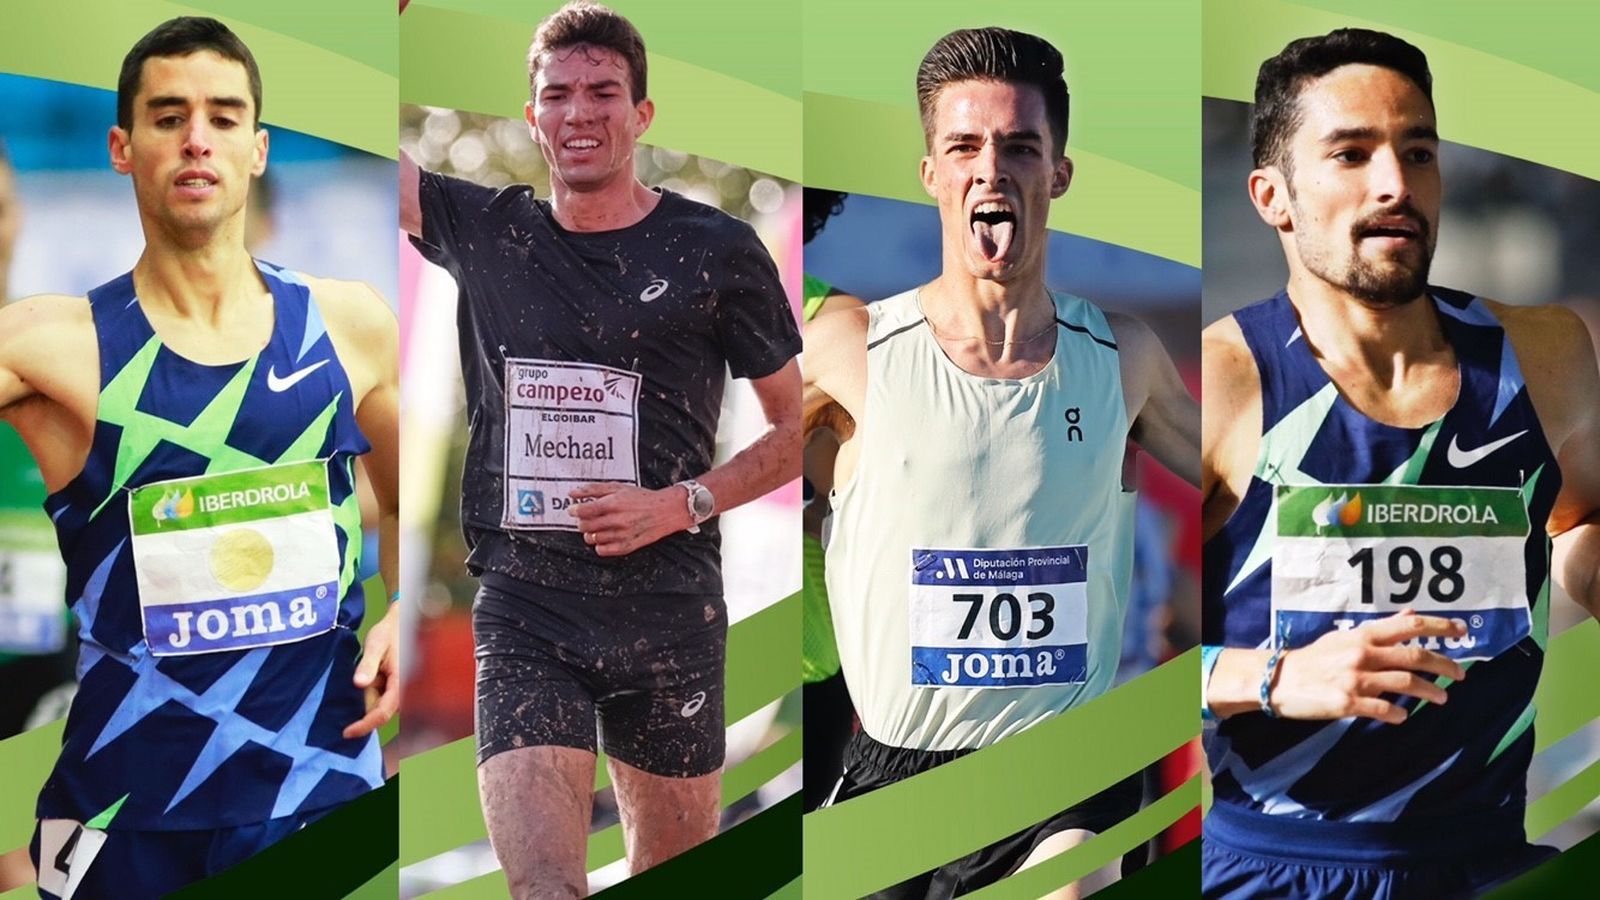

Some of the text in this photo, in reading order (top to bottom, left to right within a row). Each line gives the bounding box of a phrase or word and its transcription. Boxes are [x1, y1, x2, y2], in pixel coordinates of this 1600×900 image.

[517, 368, 548, 380] grupo
[541, 413, 596, 424] ELGOIBAR
[524, 433, 614, 460] Mechaal
[199, 481, 311, 513] IBERDROLA
[1367, 503, 1498, 525] IBERDROLA
[973, 555, 1070, 569] Diputación Provincial
[973, 570, 1024, 580] de Málaga
[1347, 545, 1465, 605] 198
[952, 592, 1056, 641] 703
